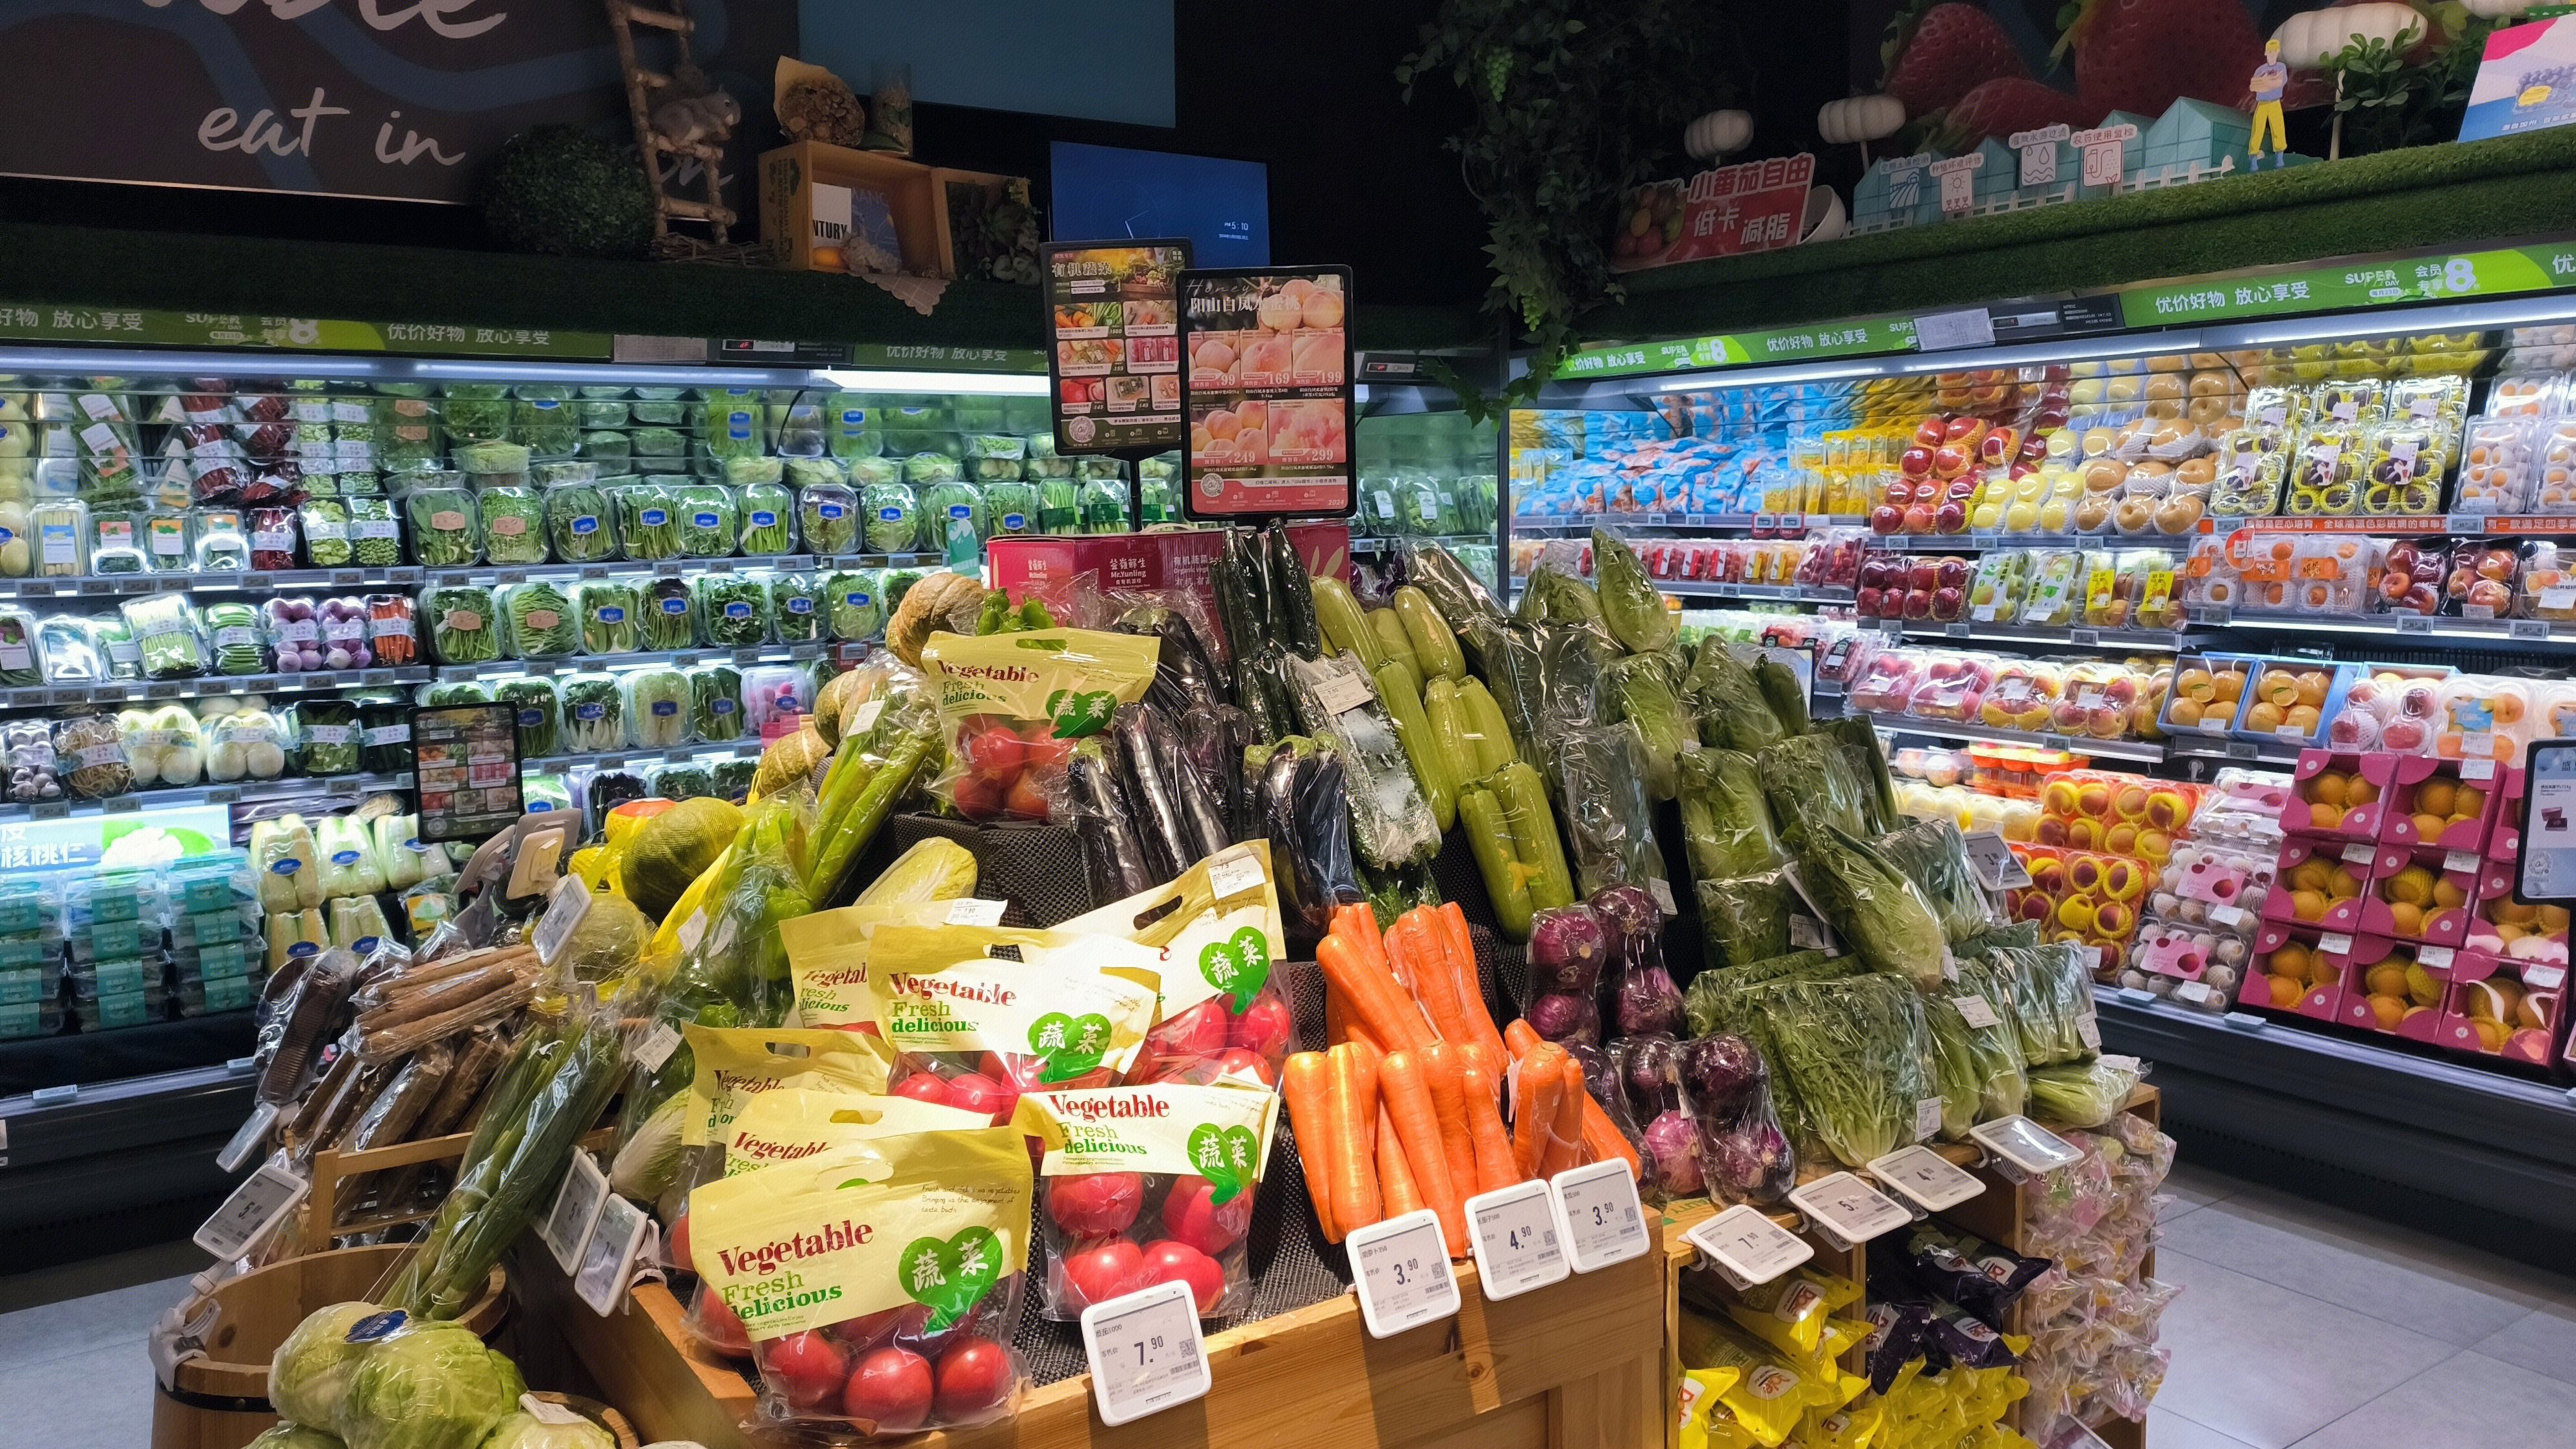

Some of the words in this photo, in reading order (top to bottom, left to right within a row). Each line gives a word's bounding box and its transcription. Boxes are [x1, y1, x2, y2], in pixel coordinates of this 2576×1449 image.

[197, 87, 351, 157] eat
[375, 110, 466, 166] in
[1690, 155, 1811, 201] 小番茄自由
[1694, 208, 1740, 238] 低卡
[1740, 213, 1791, 245] 减脂
[1051, 262, 1113, 277] 有机蔬菜
[2345, 269, 2396, 284] SUPER
[2415, 264, 2443, 277] 会员
[2444, 258, 2475, 292] 8
[2552, 255, 2576, 275] 优
[2372, 288, 2401, 297] 每月23日
[2384, 279, 2401, 287] DAY
[2417, 278, 2444, 292] 专享
[2155, 290, 2225, 314] 优价好物
[2235, 280, 2310, 306] 放心享受
[0, 308, 39, 327] 好物
[52, 310, 143, 331] 放心享受
[288, 318, 319, 344] 8
[1889, 322, 1914, 332] SUPE
[387, 323, 465, 342] 优价好物
[475, 328, 550, 345] 放心享受
[1766, 334, 1814, 352] 优价好物
[1818, 328, 1868, 347] 放心享受
[886, 345, 945, 360] 优价好物
[952, 347, 1007, 361] 放心享受
[1606, 351, 1646, 367] 放心享受
[1709, 338, 1727, 363] 8
[936, 659, 1039, 684] Vegetable
[943, 680, 985, 695] Fresh
[943, 689, 1008, 706] delicious
[1054, 696, 1109, 719] 蔬菜
[1, 841, 88, 868] 核桃仁
[1209, 935, 1263, 984] 蔬菜
[803, 961, 867, 988] Vegeta
[799, 998, 850, 1013] licious
[800, 987, 837, 1001] resh
[891, 1000, 951, 1017] Fresh
[891, 1017, 980, 1034] delicious
[1037, 1021, 1103, 1056] 蔬菜
[713, 1069, 785, 1095] Vegetabl
[1048, 1093, 1170, 1123] Vegetable
[1056, 1121, 1119, 1139] Fresh
[734, 1131, 833, 1160] Vegetabl
[1064, 1138, 1148, 1155] delicious
[1198, 1132, 1248, 1170] 蔬菜
[726, 1152, 769, 1172] Fres
[1592, 1201, 1614, 1227] 3.90
[717, 1219, 874, 1277] Vegetable
[1509, 1224, 1532, 1250] 4.90
[911, 1236, 989, 1293] 蔬菜
[1393, 1257, 1418, 1285] 3.90
[721, 1270, 806, 1306] Fresh
[1133, 1335, 1164, 1367] 7.90
